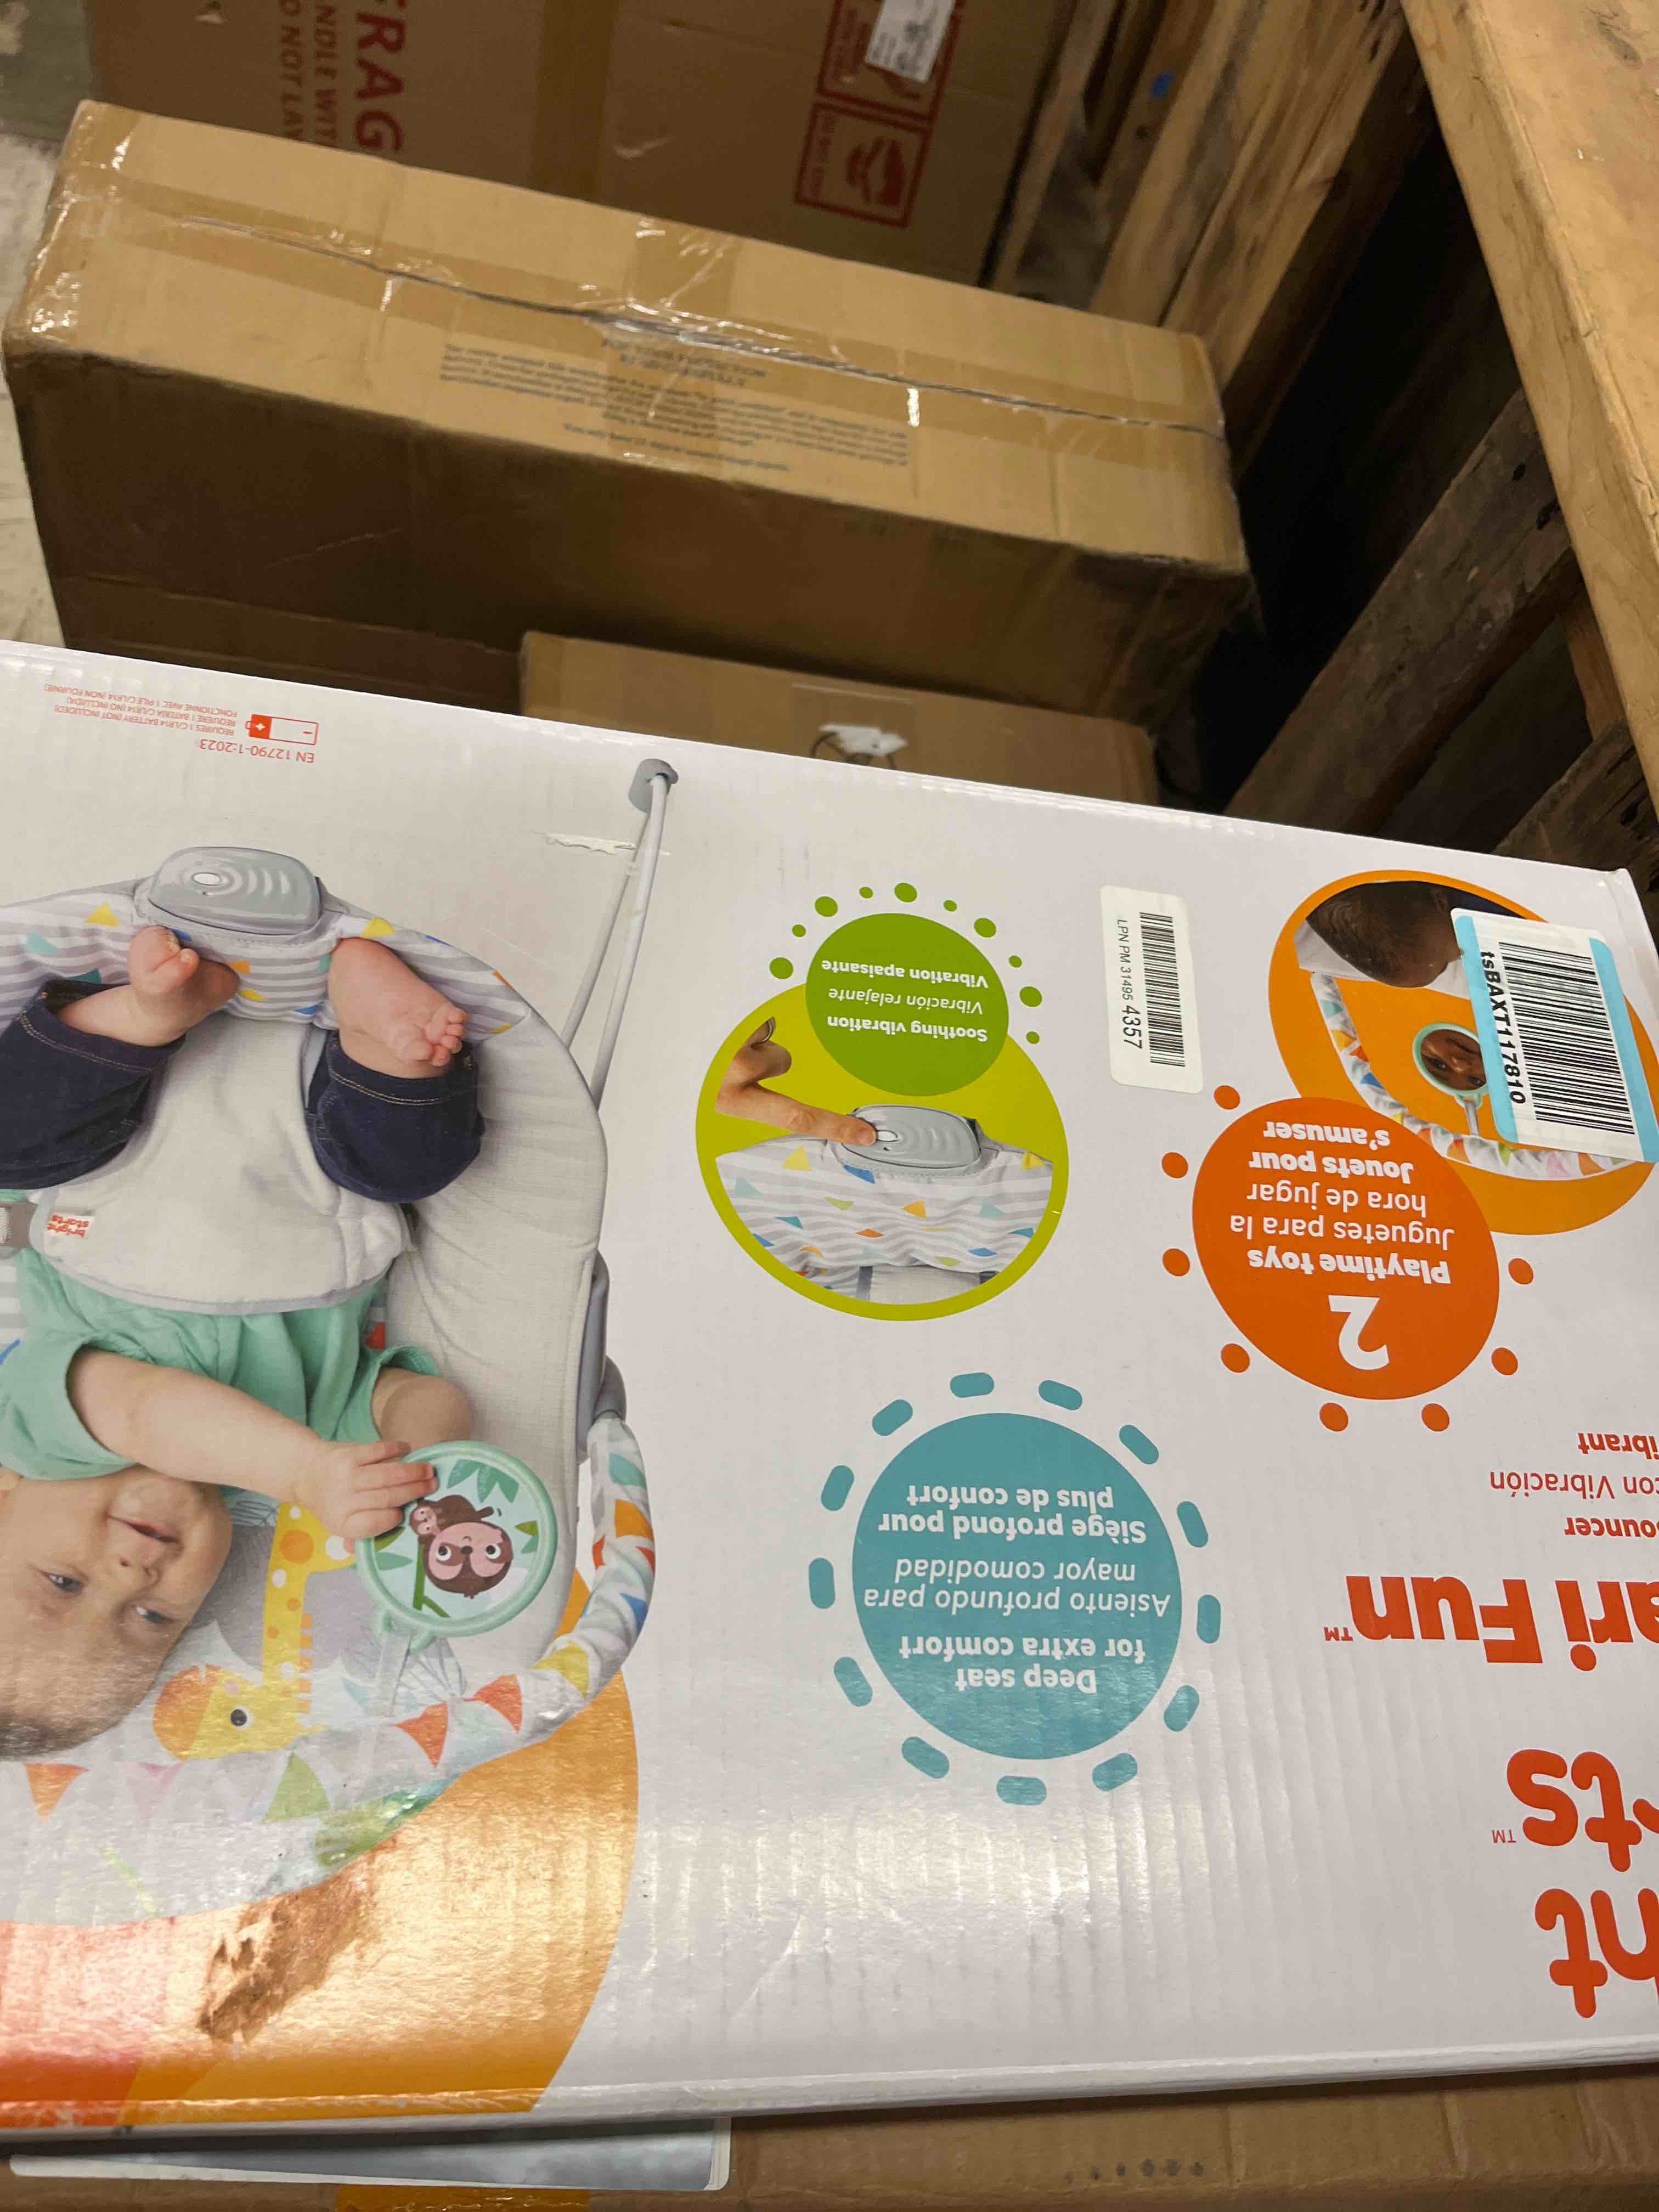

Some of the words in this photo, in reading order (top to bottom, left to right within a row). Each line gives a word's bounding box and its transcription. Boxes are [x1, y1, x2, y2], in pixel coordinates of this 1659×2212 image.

[53, 704, 100, 718] INCLUDED)
[136, 697, 155, 707] PILE
[161, 701, 184, 710] AVEC
[184, 704, 238, 718] FONCTIONNE
[122, 714, 159, 726] BATTERY
[195, 724, 235, 737] REQUIRES
[196, 715, 237, 727] REQUIERE
[198, 738, 291, 760] 12790-1:2023
[295, 751, 315, 764] EN
[1116, 919, 1128, 943] LPN
[1118, 945, 1130, 963] PM
[822, 960, 905, 978] apaisante
[910, 969, 988, 988] Vibration
[1120, 966, 1133, 1001] 31495
[828, 988, 901, 1007] relajante
[906, 996, 982, 1014] Vibración
[827, 1016, 906, 1035] vibration
[911, 1020, 988, 1042] Soothing
[1121, 1005, 1142, 1049] 4357
[1480, 951, 1526, 1104] tsBAXT117810
[1249, 1150, 1317, 1172] pour
[1322, 1157, 1414, 1184] Jouets
[1247, 1180, 1320, 1210] jugar
[1326, 1189, 1358, 1212] de
[1368, 1192, 1426, 1218] hora
[1231, 1215, 1252, 1239] la
[1263, 1215, 1324, 1237] para
[1334, 1221, 1454, 1250] Juguetes
[1248, 1246, 1314, 1275] toys
[1320, 1253, 1451, 1284] Playtime
[1328, 1295, 1389, 1370] 2
[1578, 1433, 1659, 1460] ibrant
[907, 1485, 1008, 1510] confort
[1491, 1472, 1615, 1499] Vibración
[1016, 1488, 1049, 1513] de
[1057, 1486, 1114, 1514] plus
[878, 1509, 944, 1532] pour
[953, 1513, 1064, 1541] profond
[1072, 1514, 1146, 1544] Siège
[1565, 1517, 1659, 1538] ouncer
[895, 1559, 1045, 1584] comodidad
[1054, 1557, 1135, 1581] mayor
[864, 1584, 926, 1607] para
[935, 1587, 1060, 1616] profundo
[1070, 1593, 1171, 1617] Asiento
[899, 1636, 1014, 1662] comfort
[1022, 1638, 1096, 1660] extra
[1105, 1639, 1146, 1664] for
[955, 1668, 1015, 1692] seat
[1023, 1663, 1097, 1694] Deep
